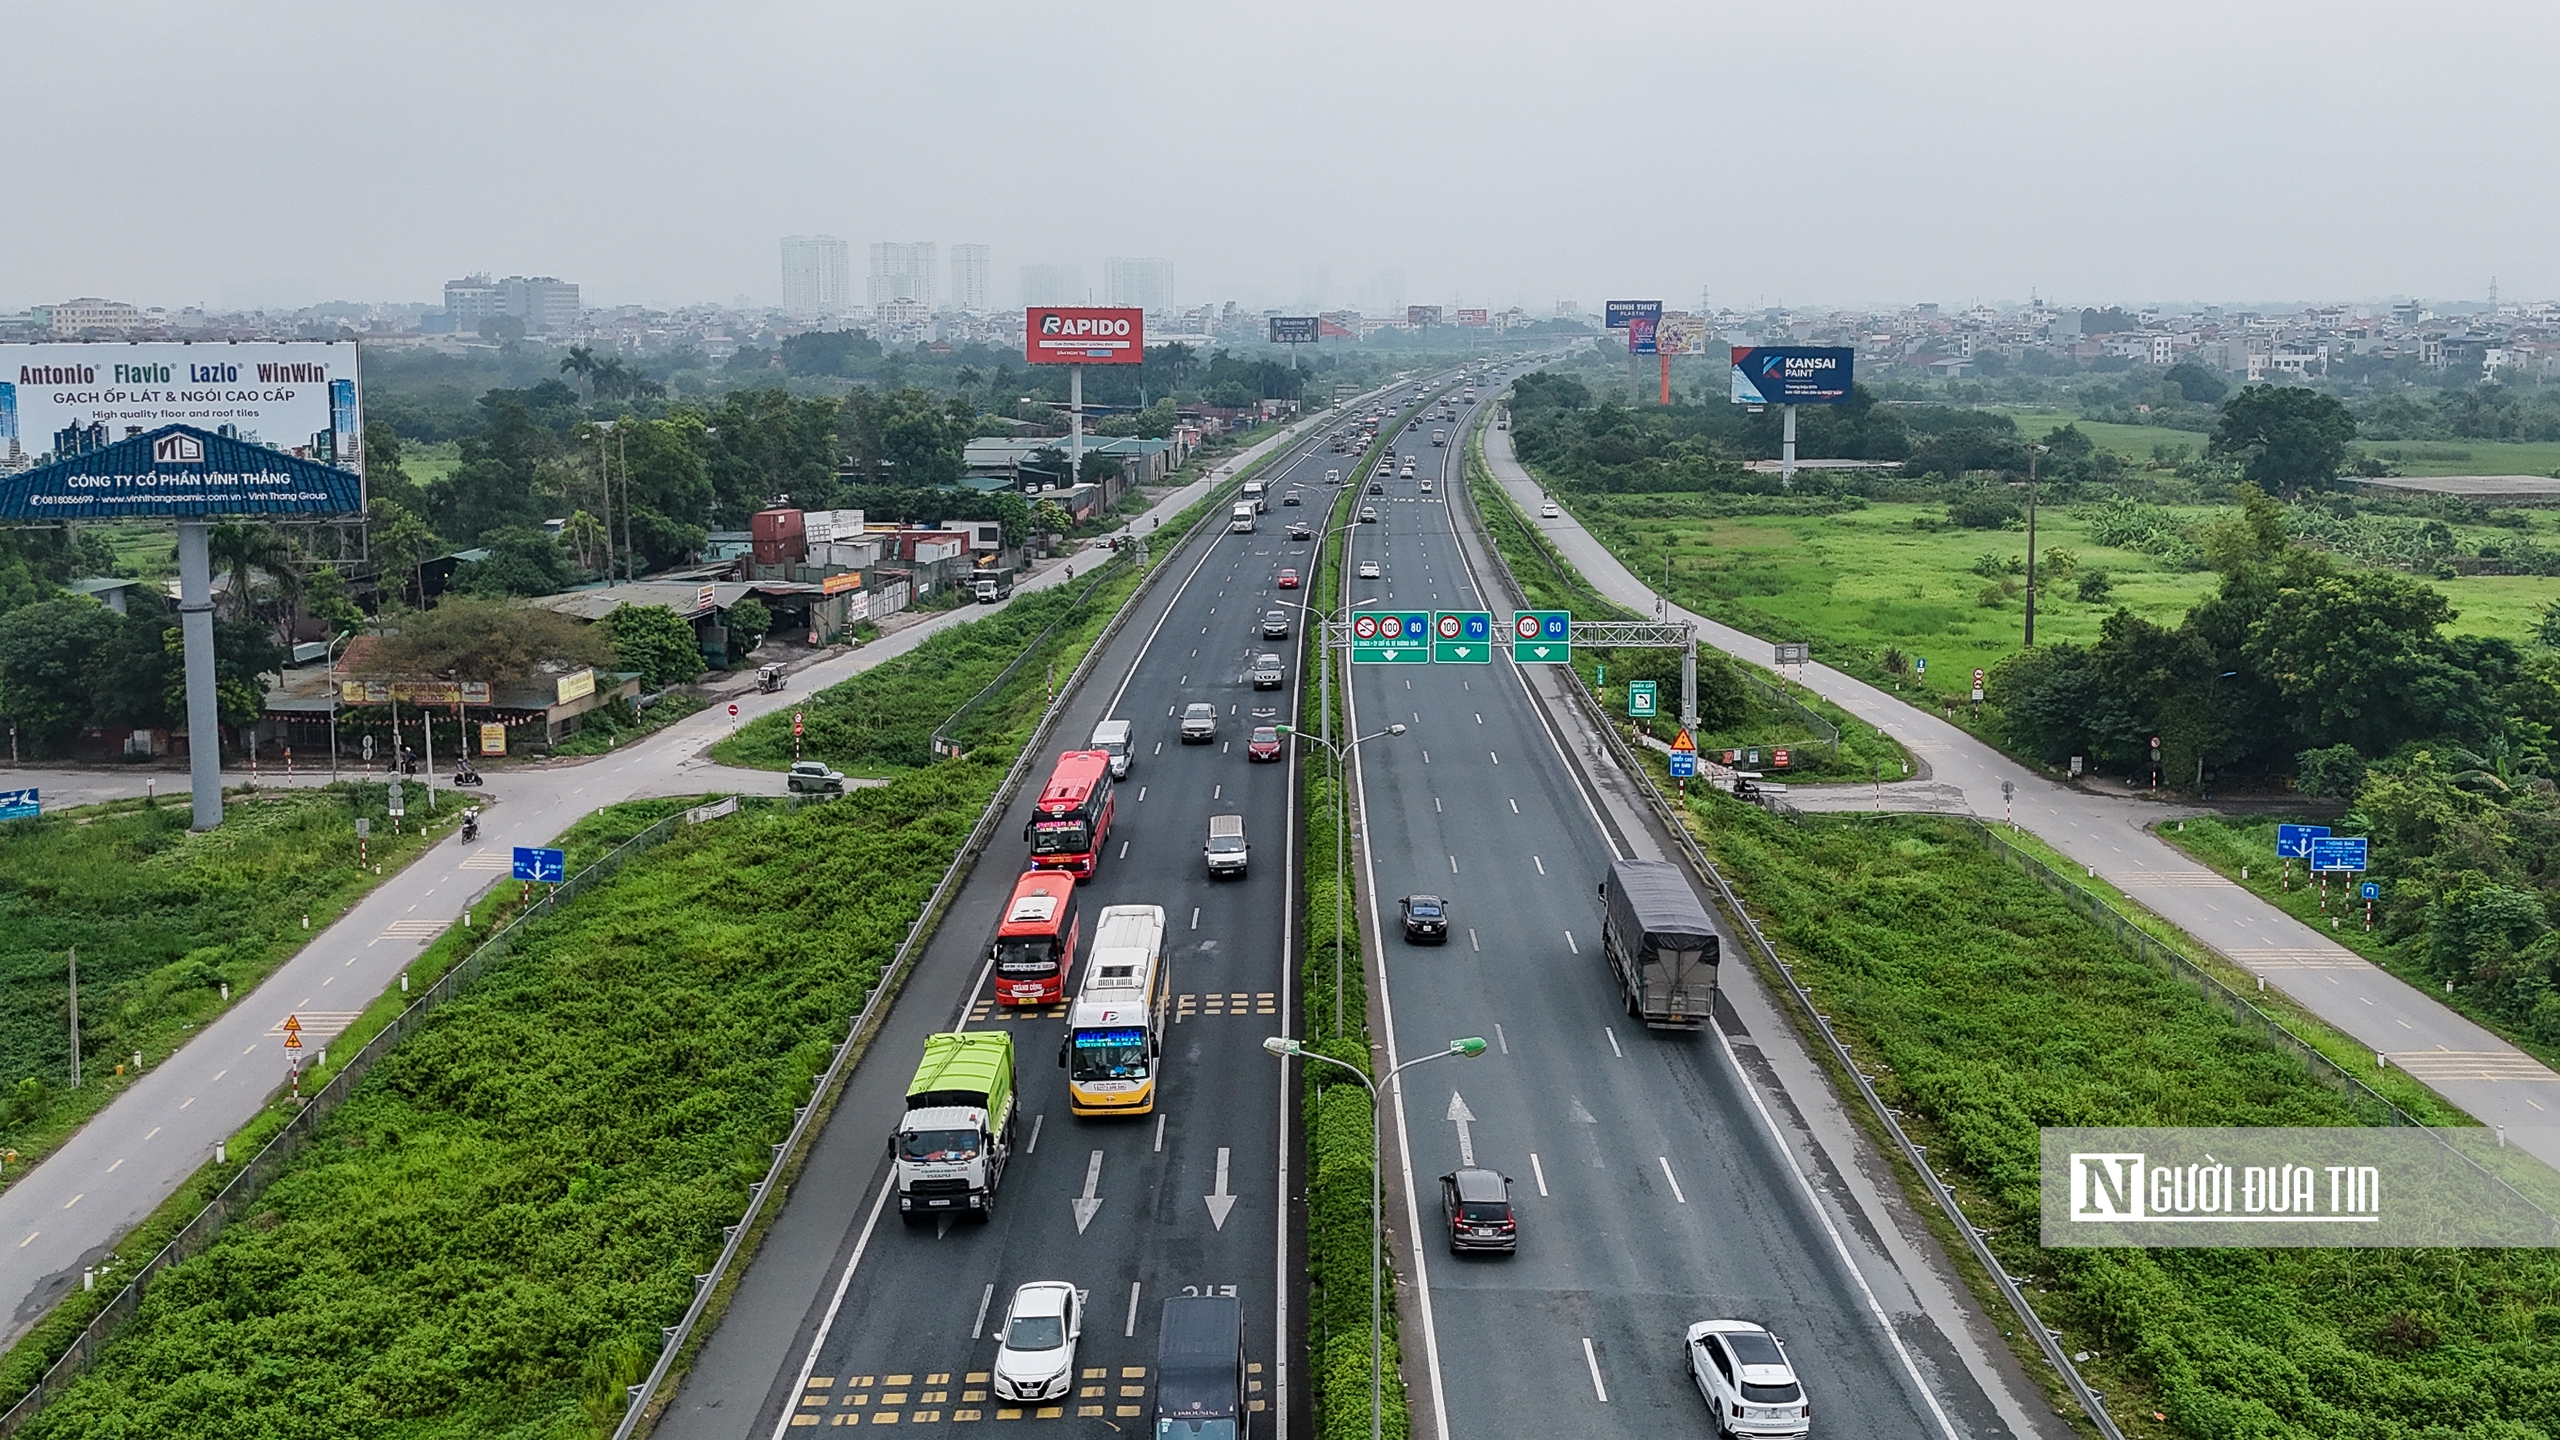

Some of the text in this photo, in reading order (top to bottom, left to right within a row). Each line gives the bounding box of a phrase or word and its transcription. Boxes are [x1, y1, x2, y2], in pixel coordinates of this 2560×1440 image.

[1042, 316, 1130, 336] RAPIDO
[1786, 358, 1836, 369] KANSAI
[53, 386, 295, 406] GẠCH ỐP LÁT & NGÓI CAO CẤP
[93, 410, 117, 420] High
[120, 410, 157, 419] quality
[161, 410, 185, 418] floor
[237, 409, 259, 417] tiles
[68, 468, 290, 488] CÔNG TY CỔ PHẦN VĨNH THẮNG
[248, 492, 268, 500] Vinh
[269, 492, 297, 501] Thang
[299, 492, 327, 500] Group
[1385, 623, 1398, 632] 100
[1410, 622, 1422, 632] 80
[1444, 622, 1456, 632] 100
[1471, 622, 1482, 632] 70
[1522, 622, 1535, 632] 100
[1549, 622, 1561, 632] 60
